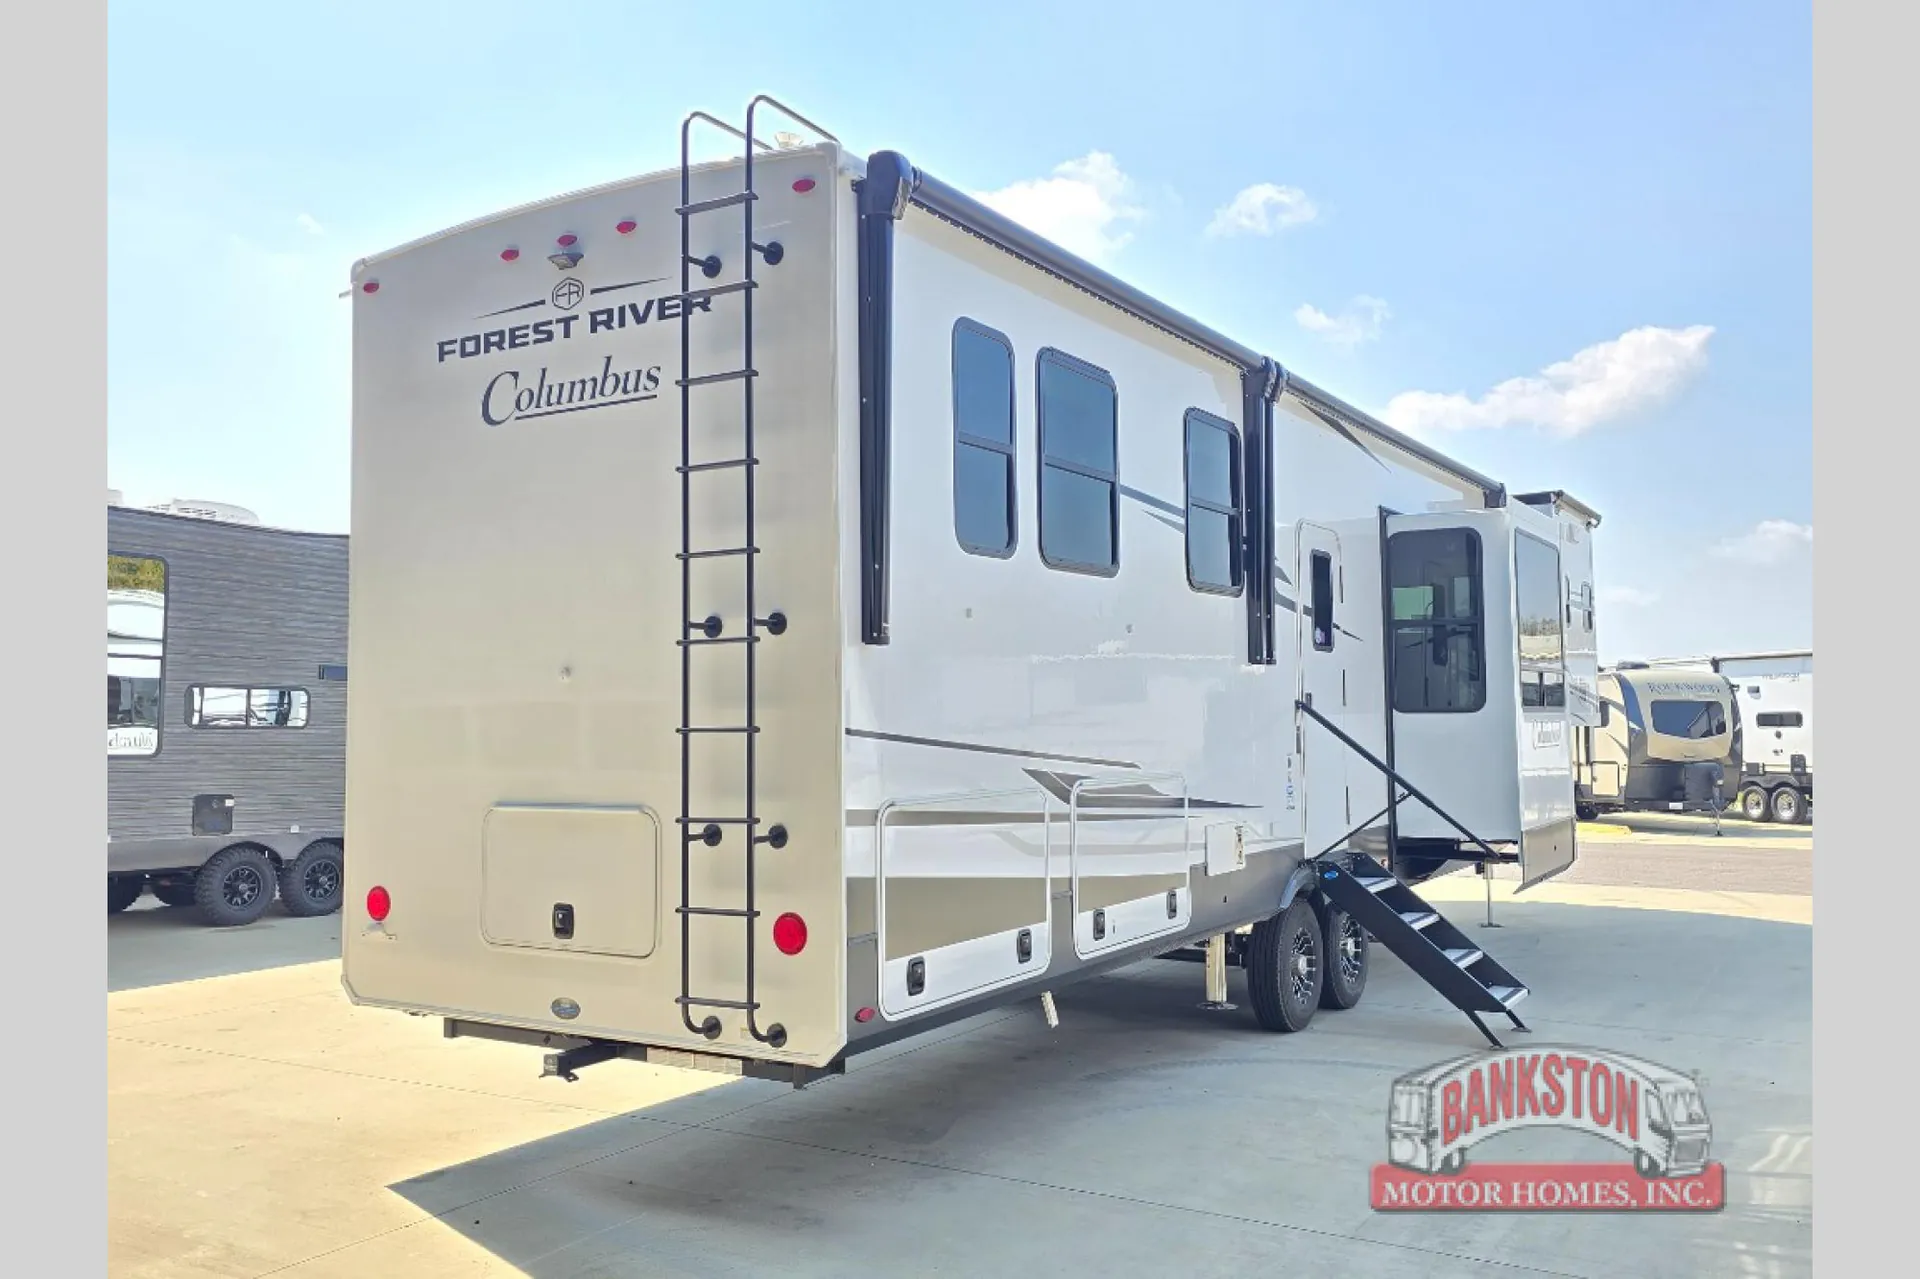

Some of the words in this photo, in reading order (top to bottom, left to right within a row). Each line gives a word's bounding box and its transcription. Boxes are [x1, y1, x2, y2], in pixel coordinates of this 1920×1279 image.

[436, 315, 579, 363] FOREST
[588, 295, 712, 334] RIVER
[481, 355, 661, 426] Columbus
